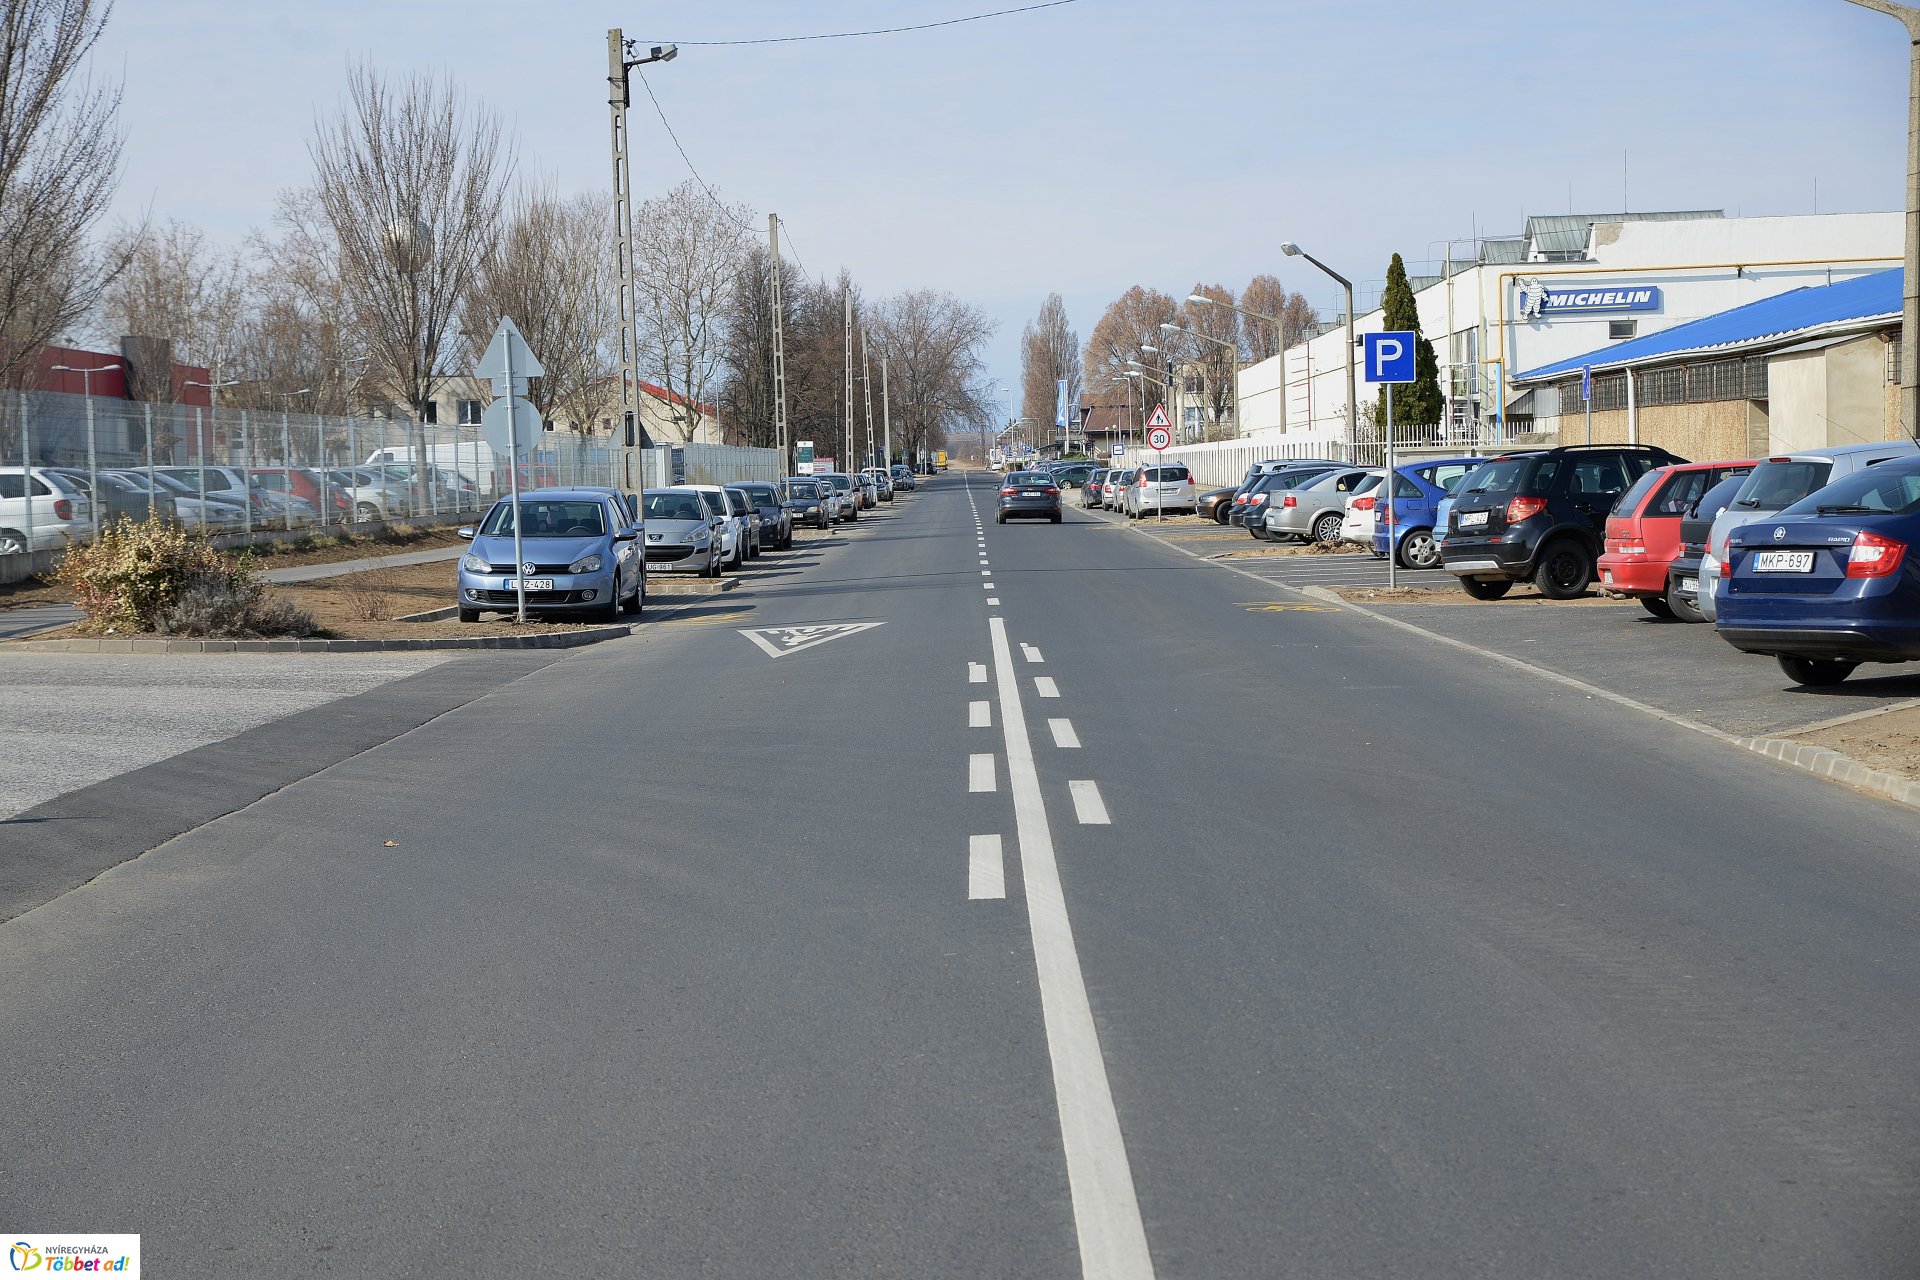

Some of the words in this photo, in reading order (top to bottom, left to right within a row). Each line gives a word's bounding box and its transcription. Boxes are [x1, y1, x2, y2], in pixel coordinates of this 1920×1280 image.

[1547, 291, 1651, 307] MICHELIN
[1376, 340, 1403, 376] P
[1154, 435, 1165, 444] 30
[1760, 554, 1810, 568] MKP-697
[511, 580, 551, 589] LZ-428
